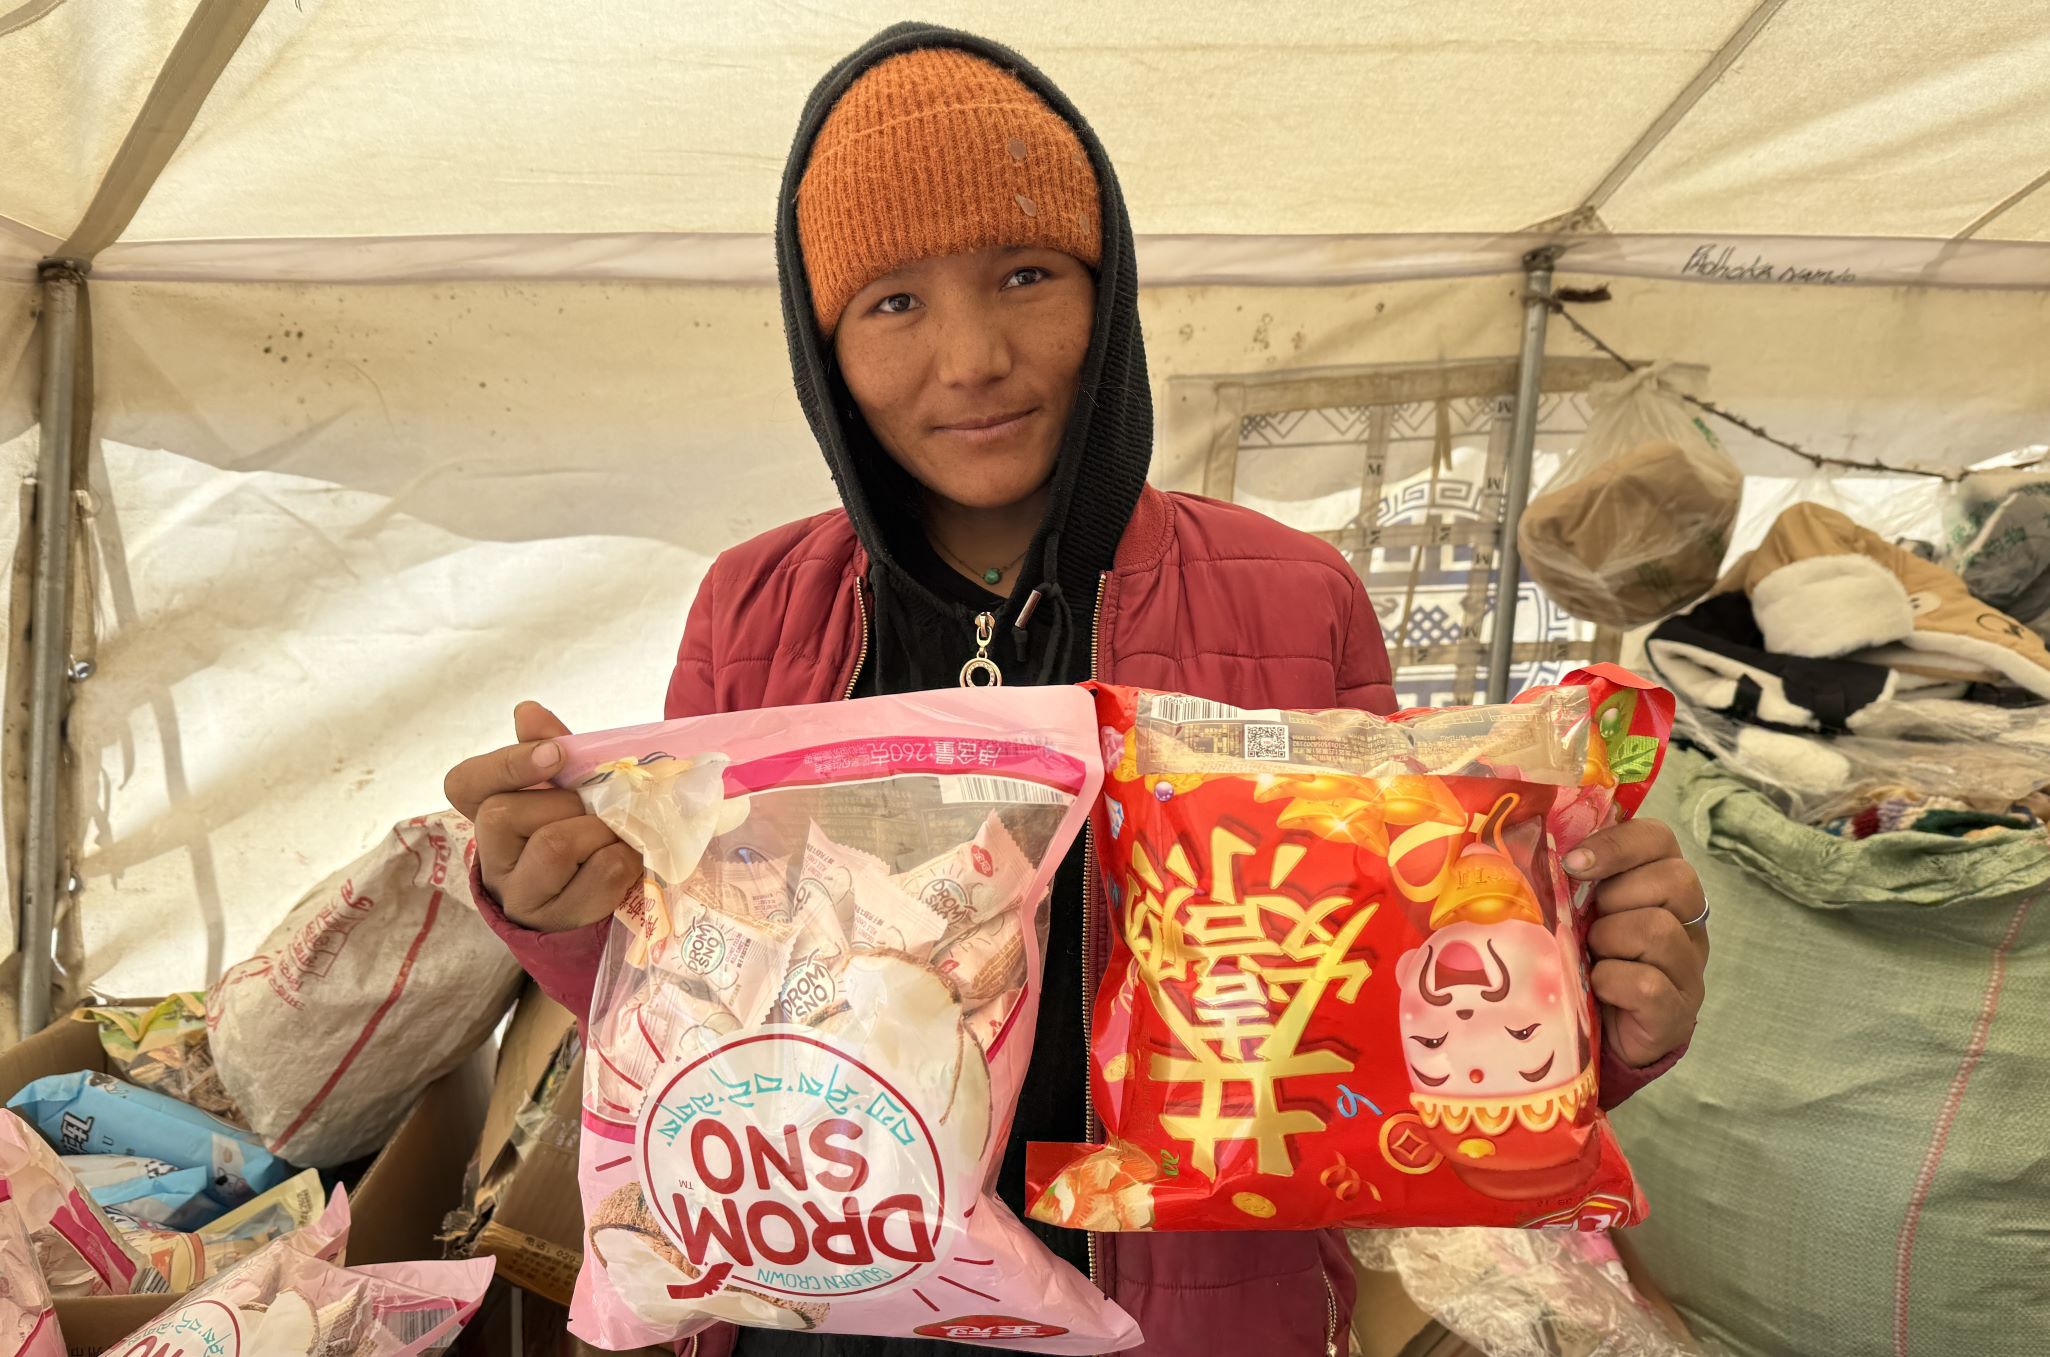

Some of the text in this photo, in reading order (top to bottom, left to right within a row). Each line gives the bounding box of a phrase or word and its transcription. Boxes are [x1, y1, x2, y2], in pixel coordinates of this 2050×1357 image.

[867, 741, 1002, 767] 净含量:260克
[931, 880, 966, 920] DROM
[687, 926, 712, 973] DROM
[699, 935, 721, 969] SNO
[780, 965, 826, 1016] DROM
[795, 984, 828, 1018] SNO
[690, 1117, 870, 1195] SNO
[671, 1192, 936, 1267] DROM
[757, 1265, 893, 1291] GOLDEN CROWN
